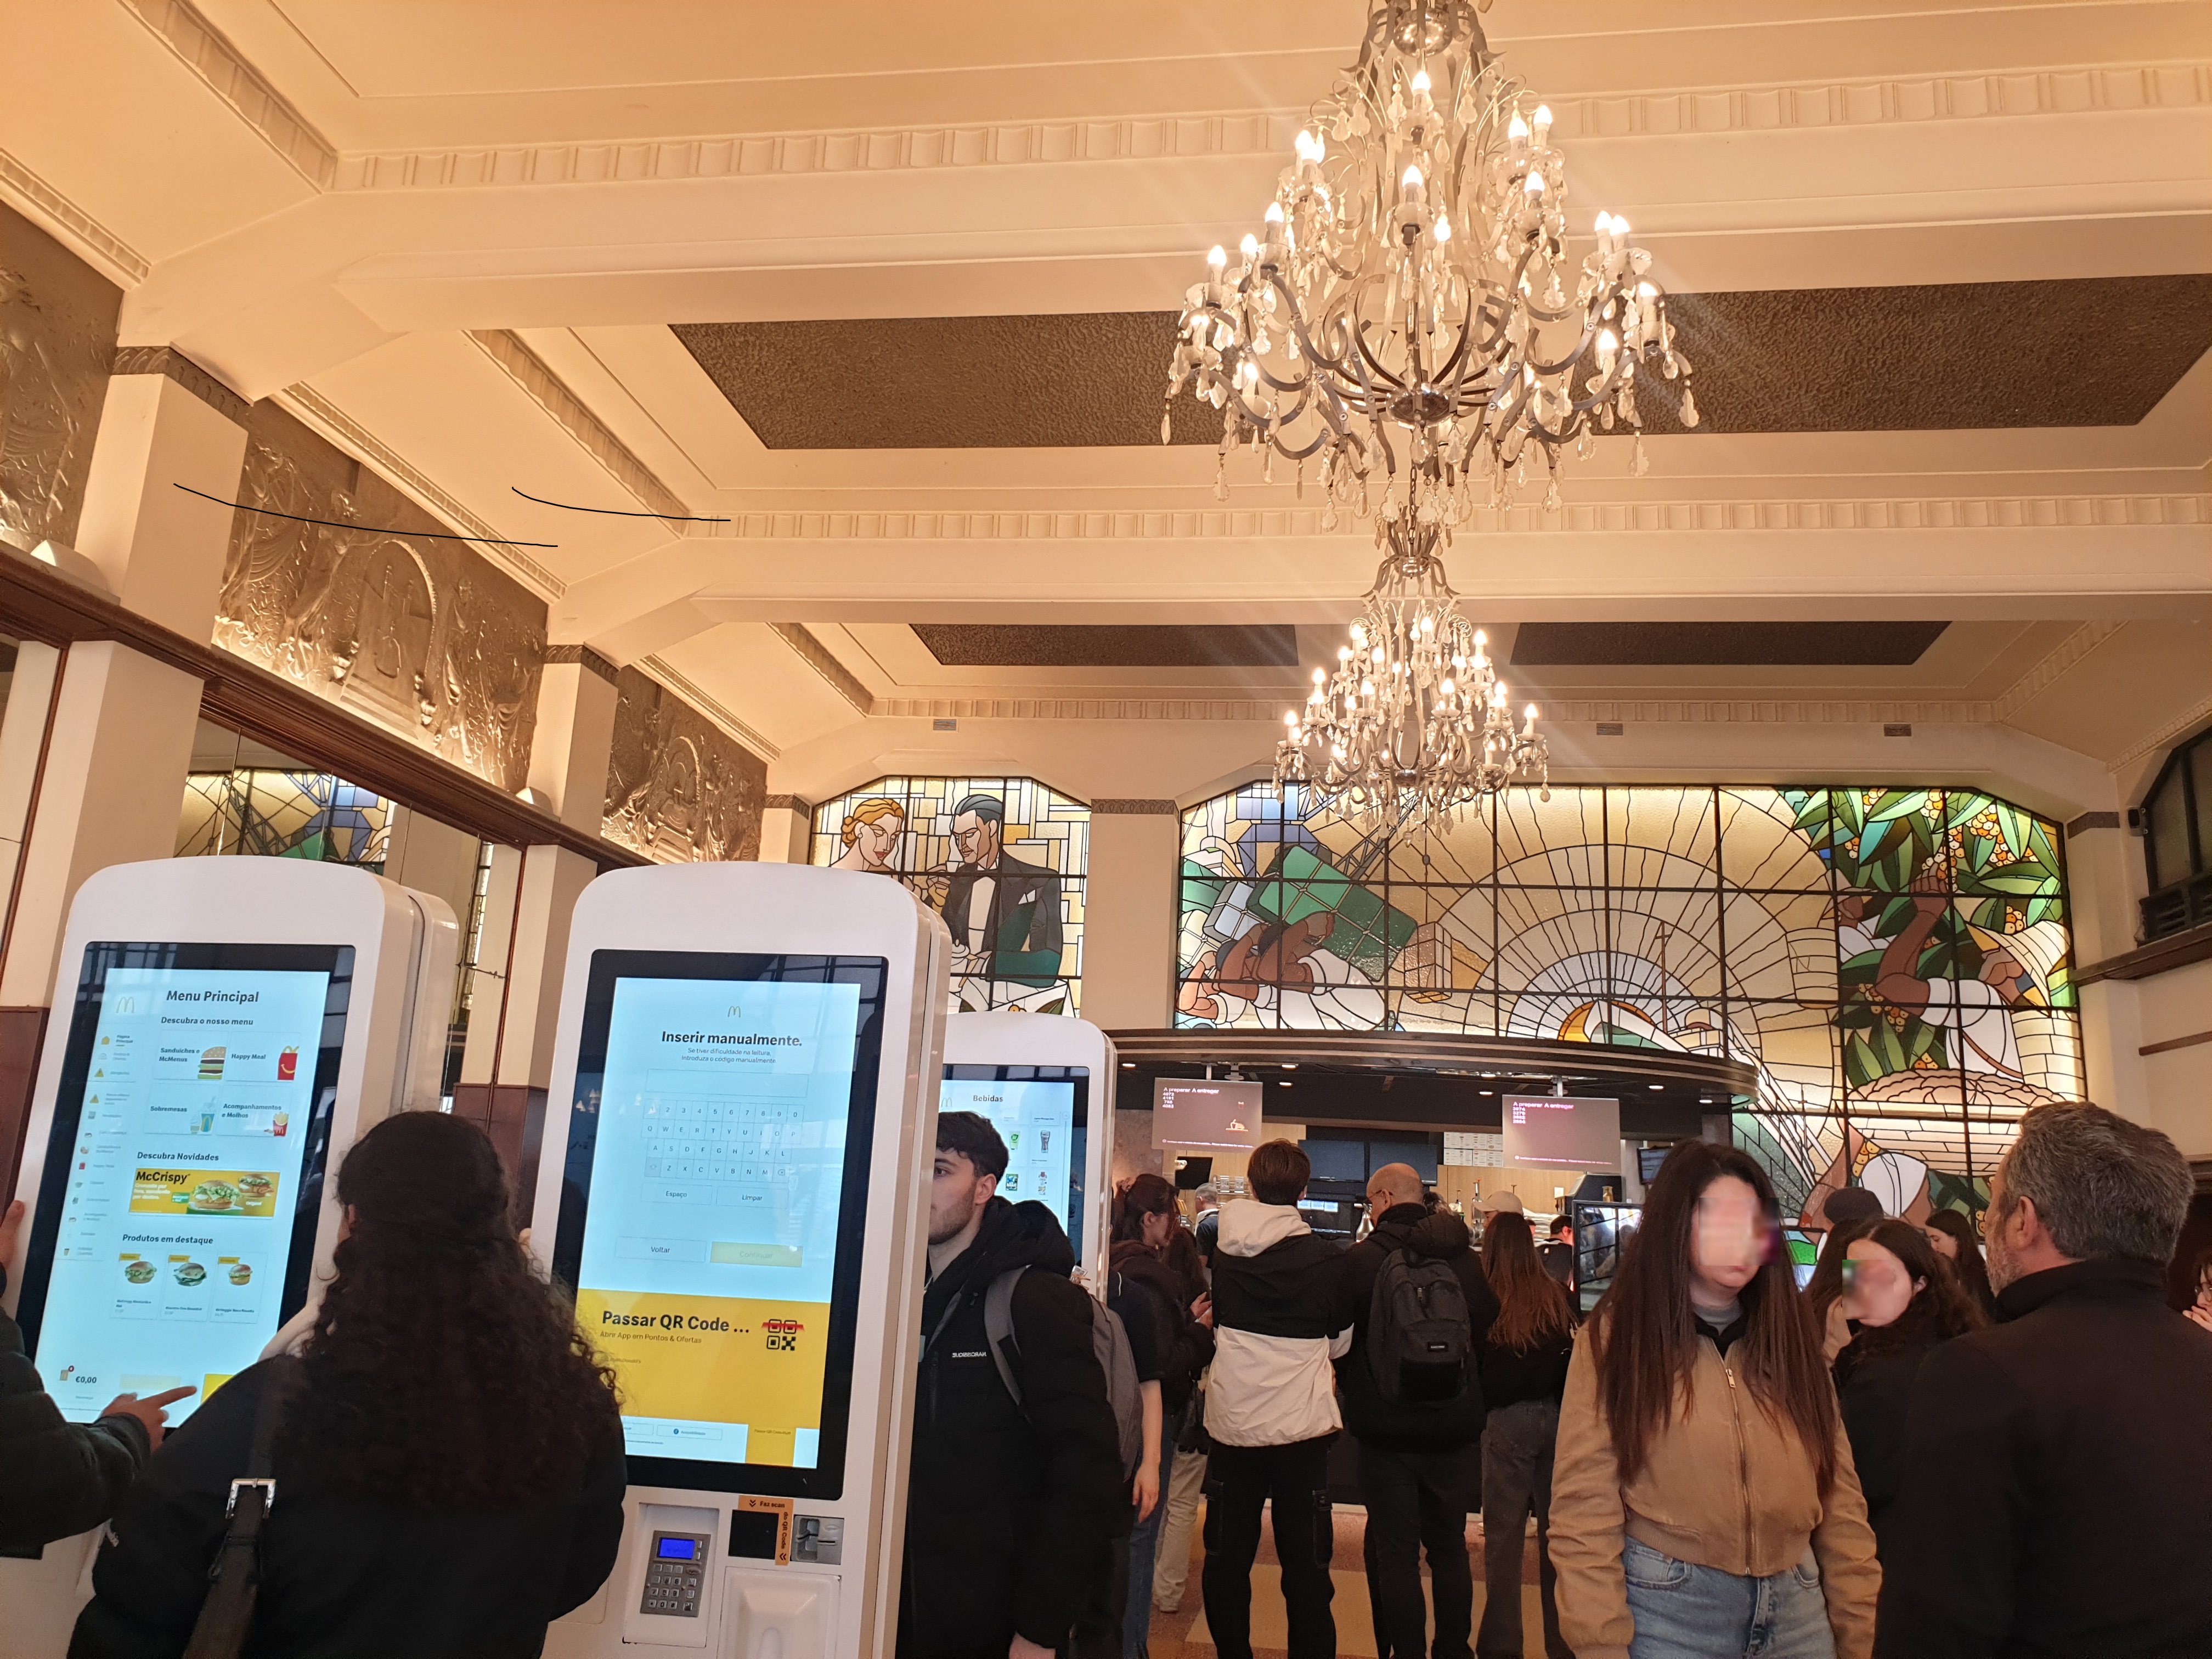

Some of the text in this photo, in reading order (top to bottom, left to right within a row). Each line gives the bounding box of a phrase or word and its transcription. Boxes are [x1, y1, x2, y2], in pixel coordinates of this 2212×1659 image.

[166, 991, 259, 1005] Menu Principal
[662, 1031, 802, 1046] Inserir manualmente.
[715, 1056, 735, 1064] código
[137, 1152, 219, 1161] Descubra Novidades
[136, 1171, 188, 1184] McCrispy
[665, 1190, 687, 1199] Espaço
[122, 1234, 159, 1243] Produtos
[175, 1236, 213, 1245] destaque
[602, 1311, 656, 1327] Passar
[660, 1314, 684, 1330] QR
[688, 1316, 730, 1331] Code
[618, 1332, 631, 1340] App
[76, 1376, 97, 1384] €0,00
[783, 1511, 788, 1520] do
[782, 1521, 788, 1531] QR
